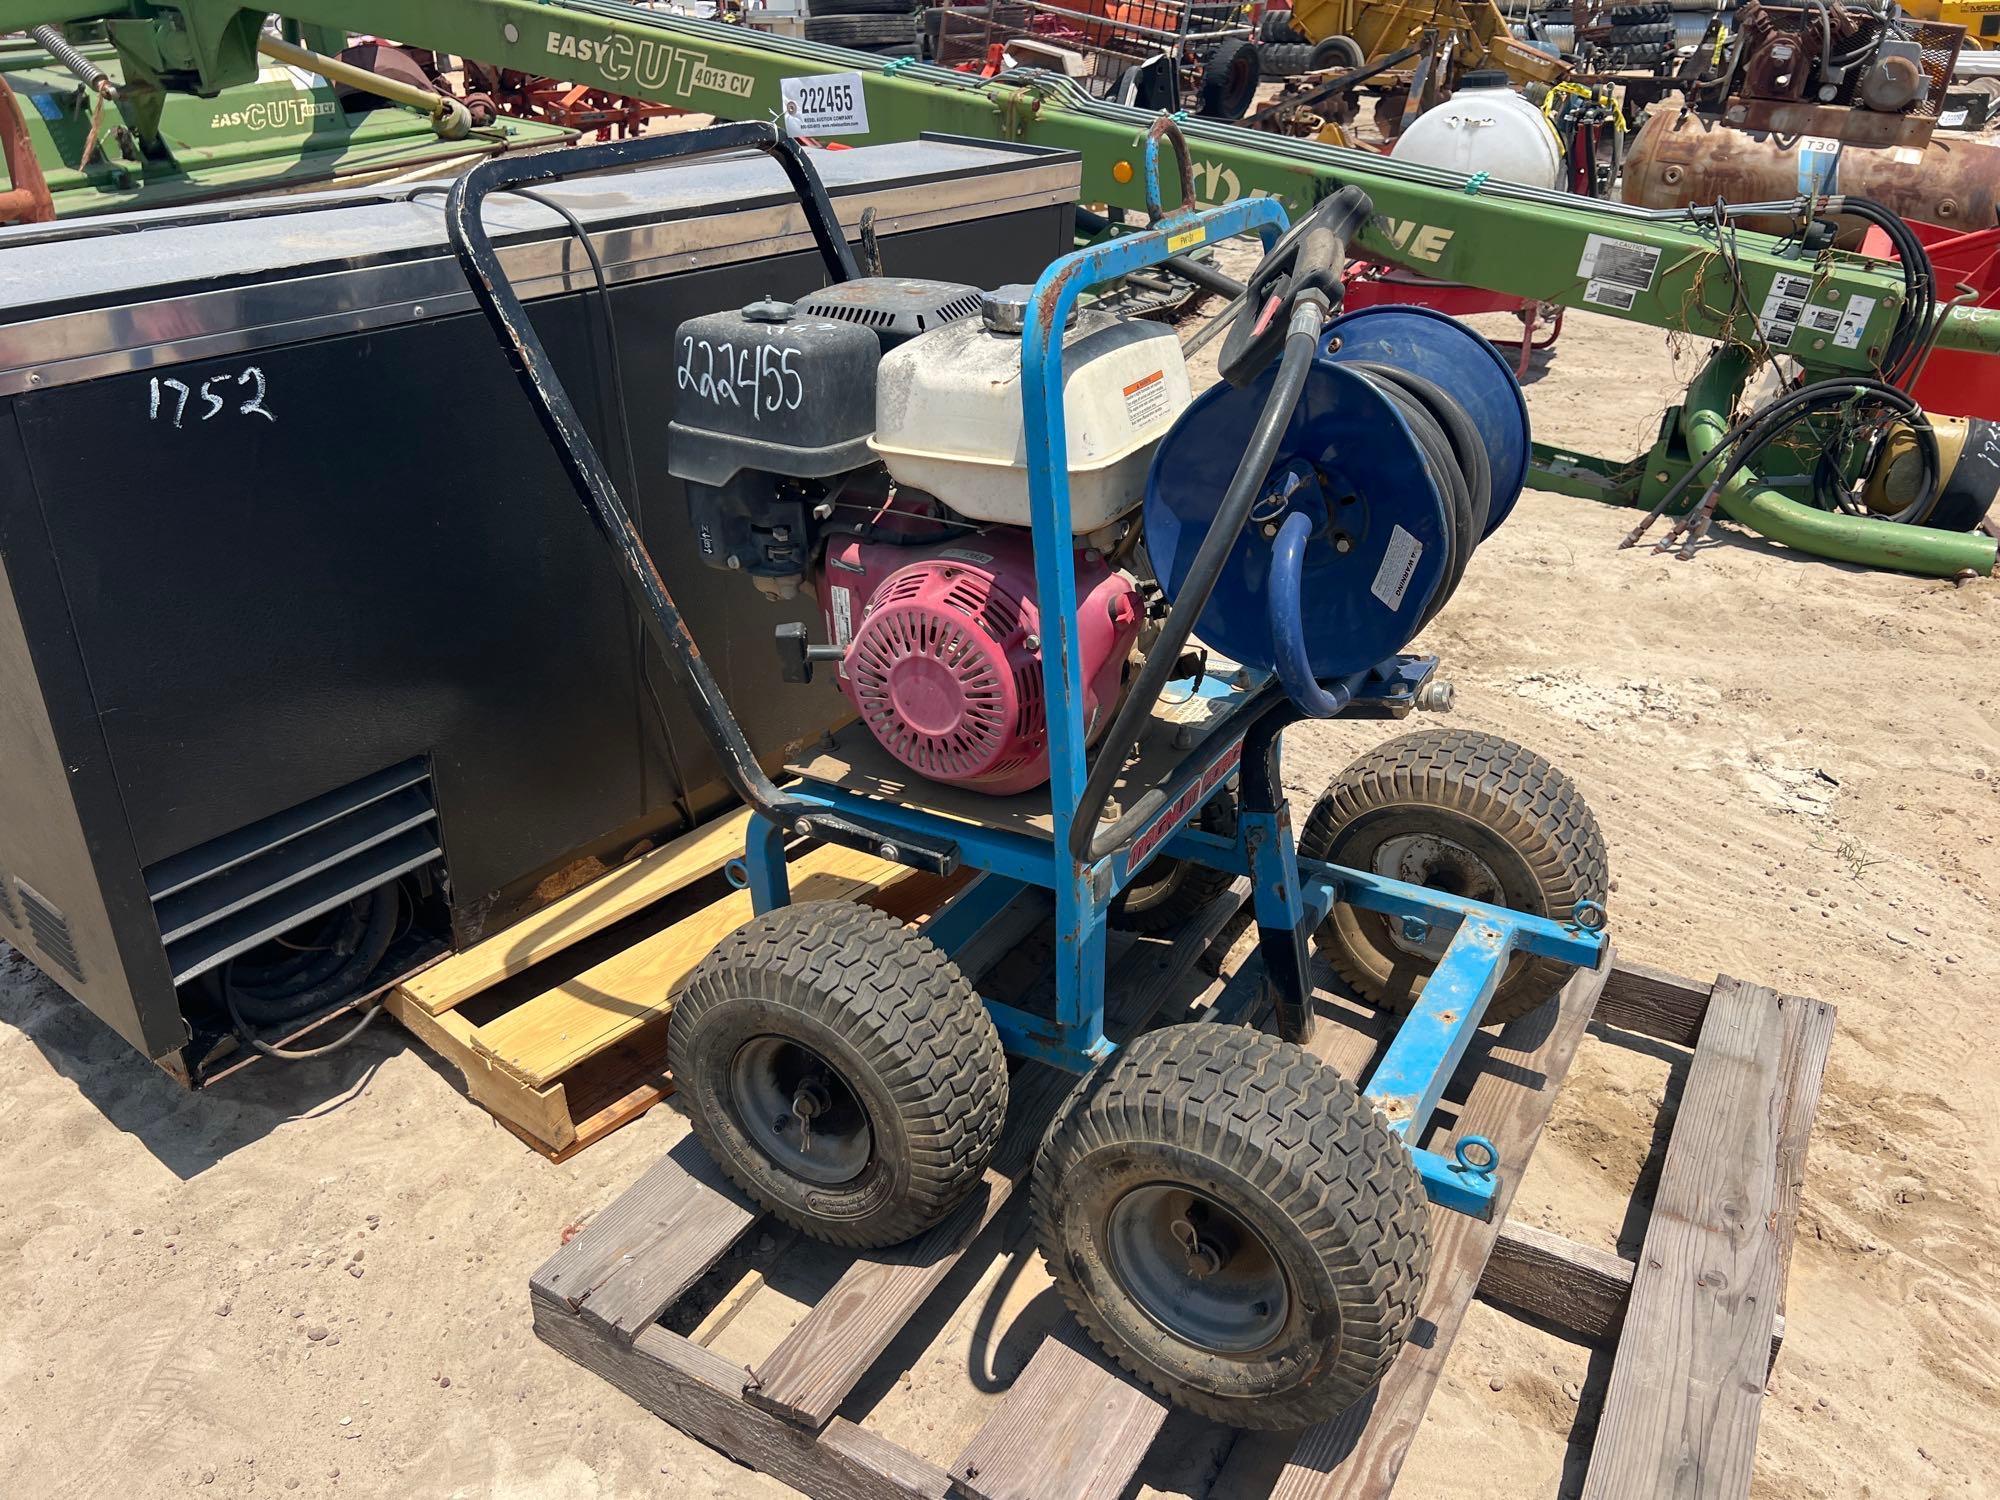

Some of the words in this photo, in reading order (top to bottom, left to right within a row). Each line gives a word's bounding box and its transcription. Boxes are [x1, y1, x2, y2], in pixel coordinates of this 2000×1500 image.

[694, 68, 726, 89] 4013
[729, 75, 750, 94] CV
[800, 85, 853, 114] 222455
[1807, 140, 1836, 152] T30
[677, 336, 803, 421] 222455
[149, 366, 278, 429] 1752
[1395, 559, 1415, 597] WARNING
